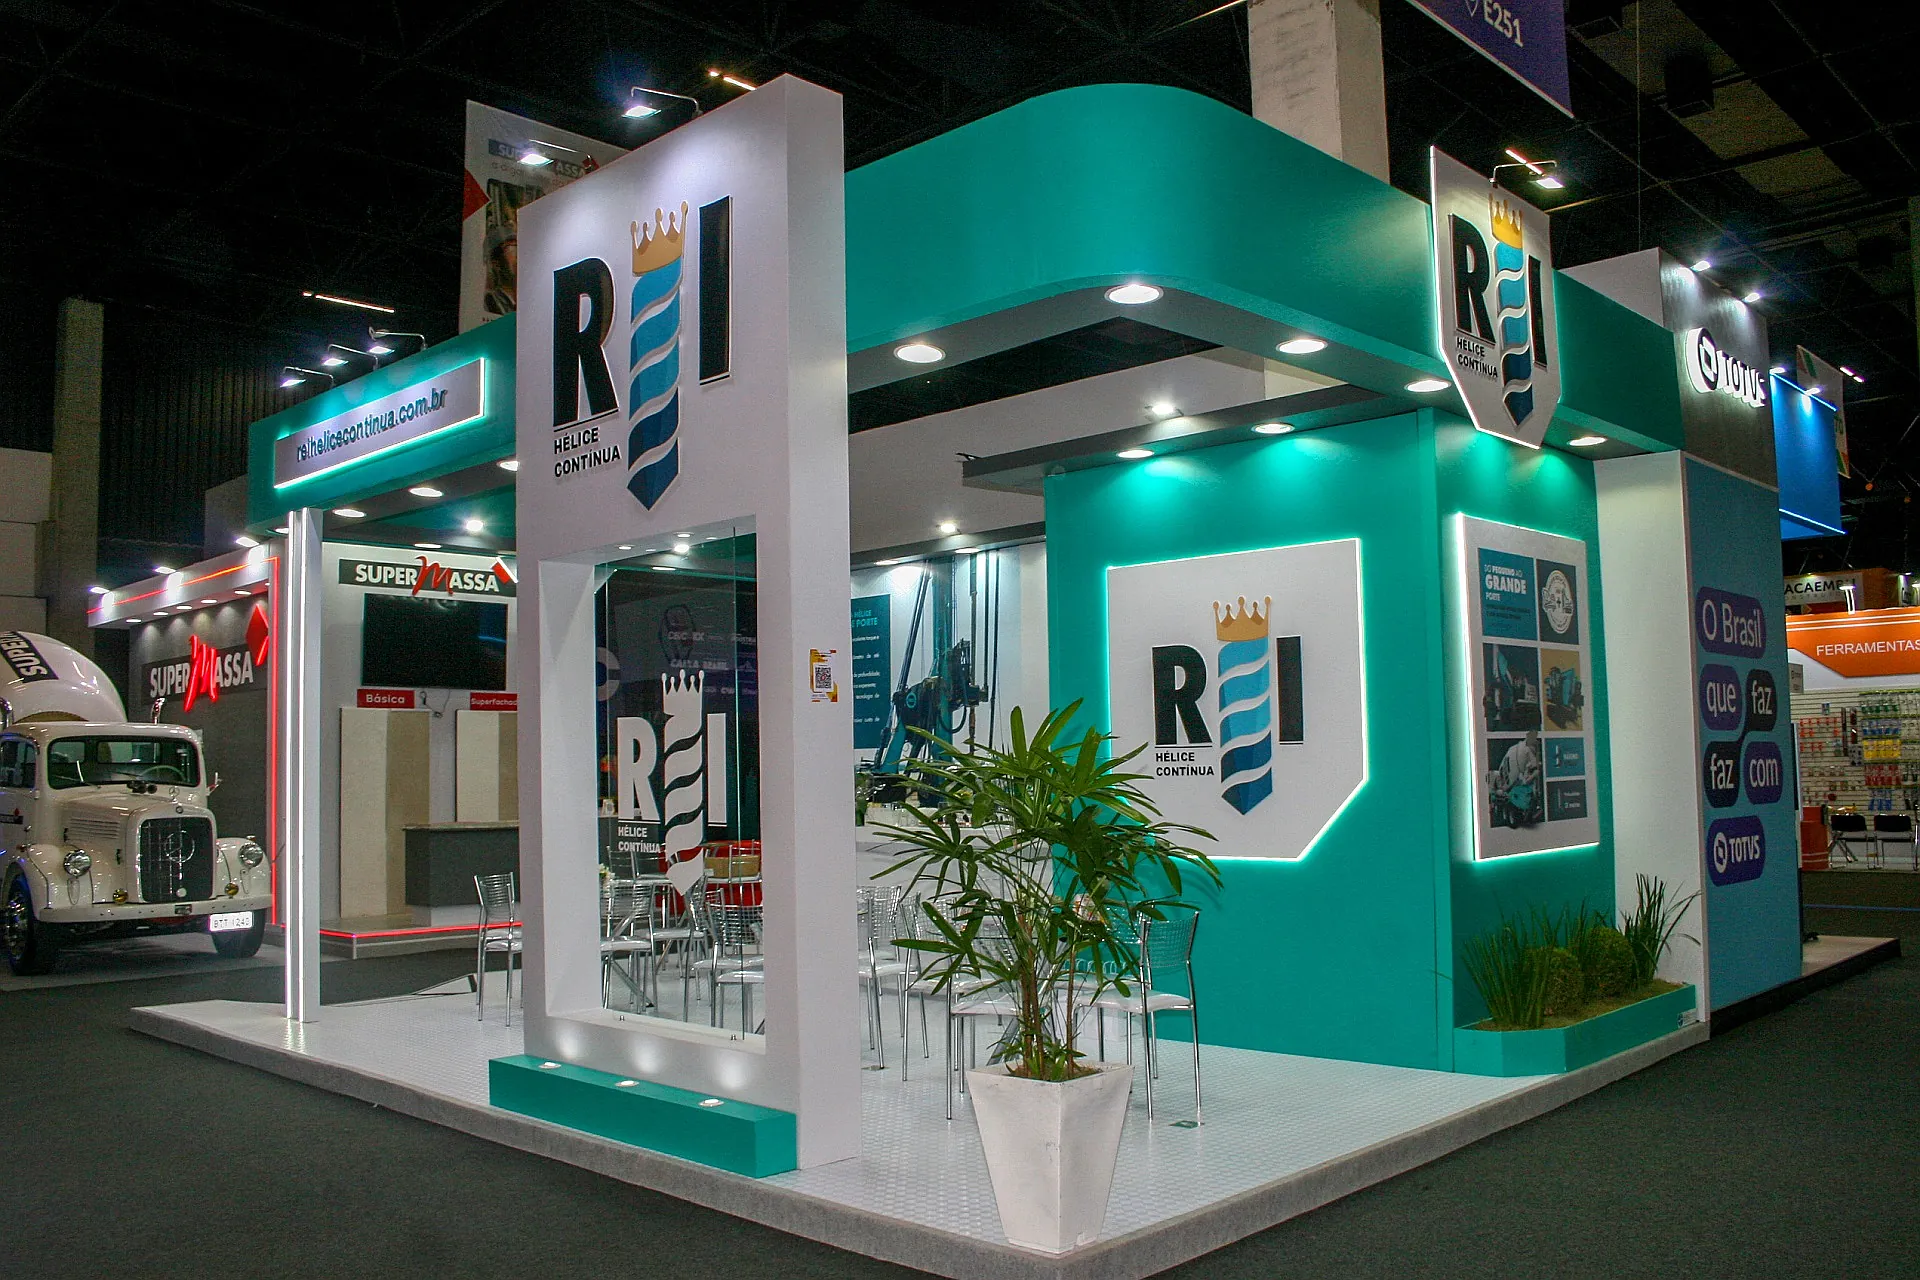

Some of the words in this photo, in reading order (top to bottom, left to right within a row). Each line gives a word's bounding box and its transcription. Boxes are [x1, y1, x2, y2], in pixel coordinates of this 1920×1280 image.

[1483, 0, 1524, 48] E251
[1457, 353, 1498, 378] CONTÍNUA
[296, 387, 448, 463] reihelicecontinua.com.br
[554, 426, 599, 455] HÉLICE
[554, 444, 621, 478] CONTÍNUA
[1485, 573, 1527, 595] GRANDE
[1784, 578, 1856, 595] ACAEMB
[1702, 599, 1717, 641] O
[1721, 602, 1762, 648] Brasil
[1815, 639, 1920, 657] FERRAMENTAS
[365, 693, 405, 704] Básica
[1706, 681, 1736, 718] que
[1751, 680, 1773, 715] faz
[1155, 751, 1195, 763] HÉLICE
[1156, 763, 1215, 776] CONTÍNUA
[1710, 752, 1734, 790] faz
[1749, 758, 1779, 788] com
[618, 826, 648, 838] HÉLICE
[618, 840, 661, 854] CONTÍNUA
[1728, 835, 1760, 864] TOTVS
